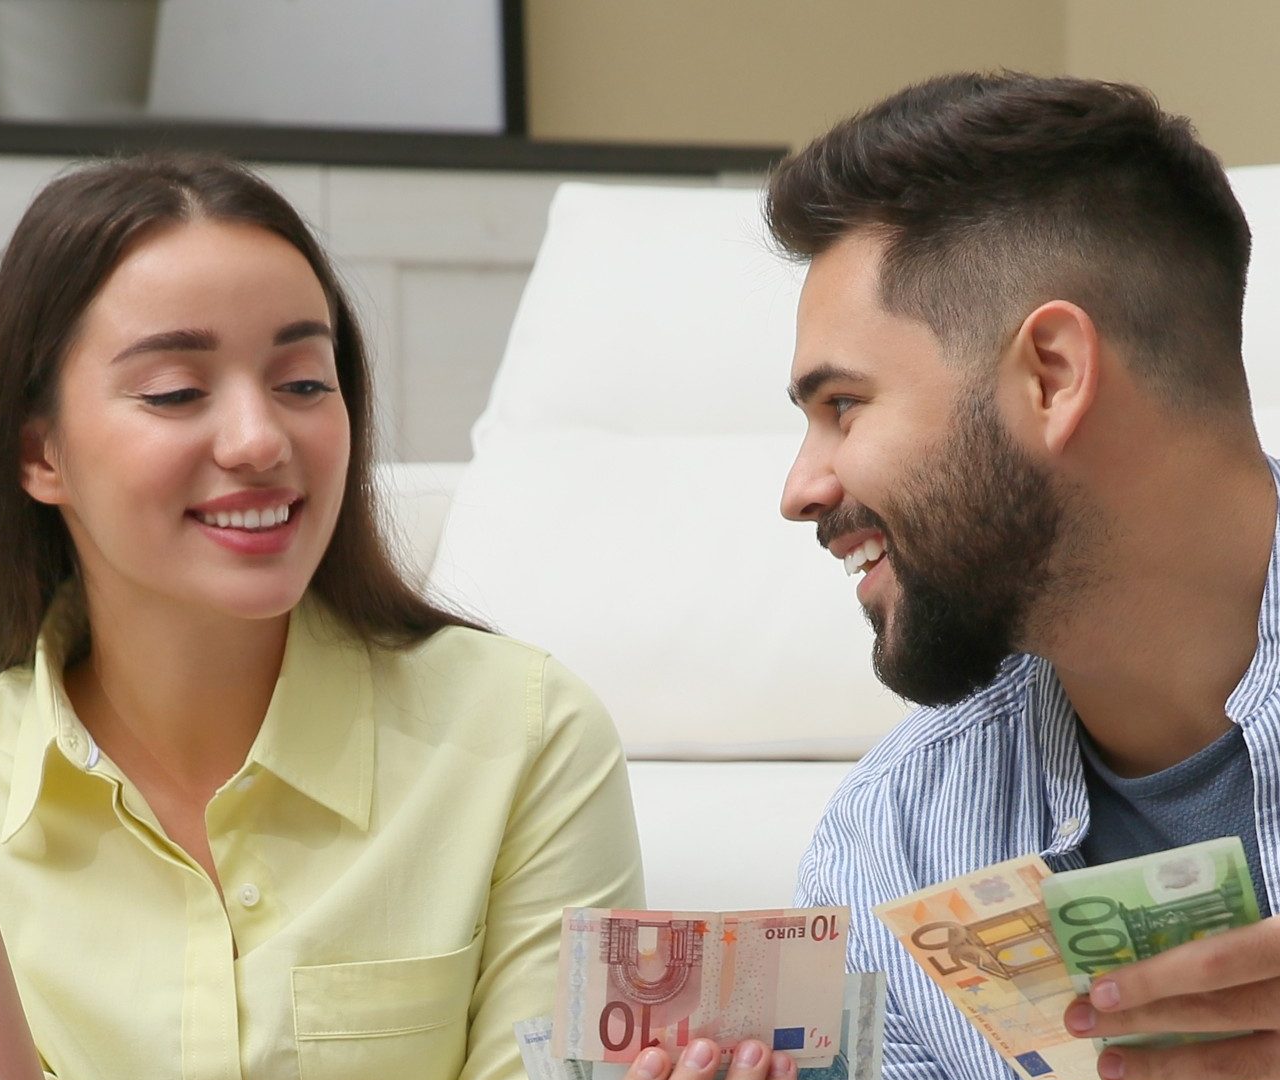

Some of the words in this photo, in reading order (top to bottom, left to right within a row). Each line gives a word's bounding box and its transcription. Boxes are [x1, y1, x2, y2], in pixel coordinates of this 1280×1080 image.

[765, 927, 805, 939] EURO
[811, 915, 839, 941] 10
[911, 920, 968, 976] 50
[1058, 895, 1133, 974] 100
[599, 1001, 660, 1051] 10
